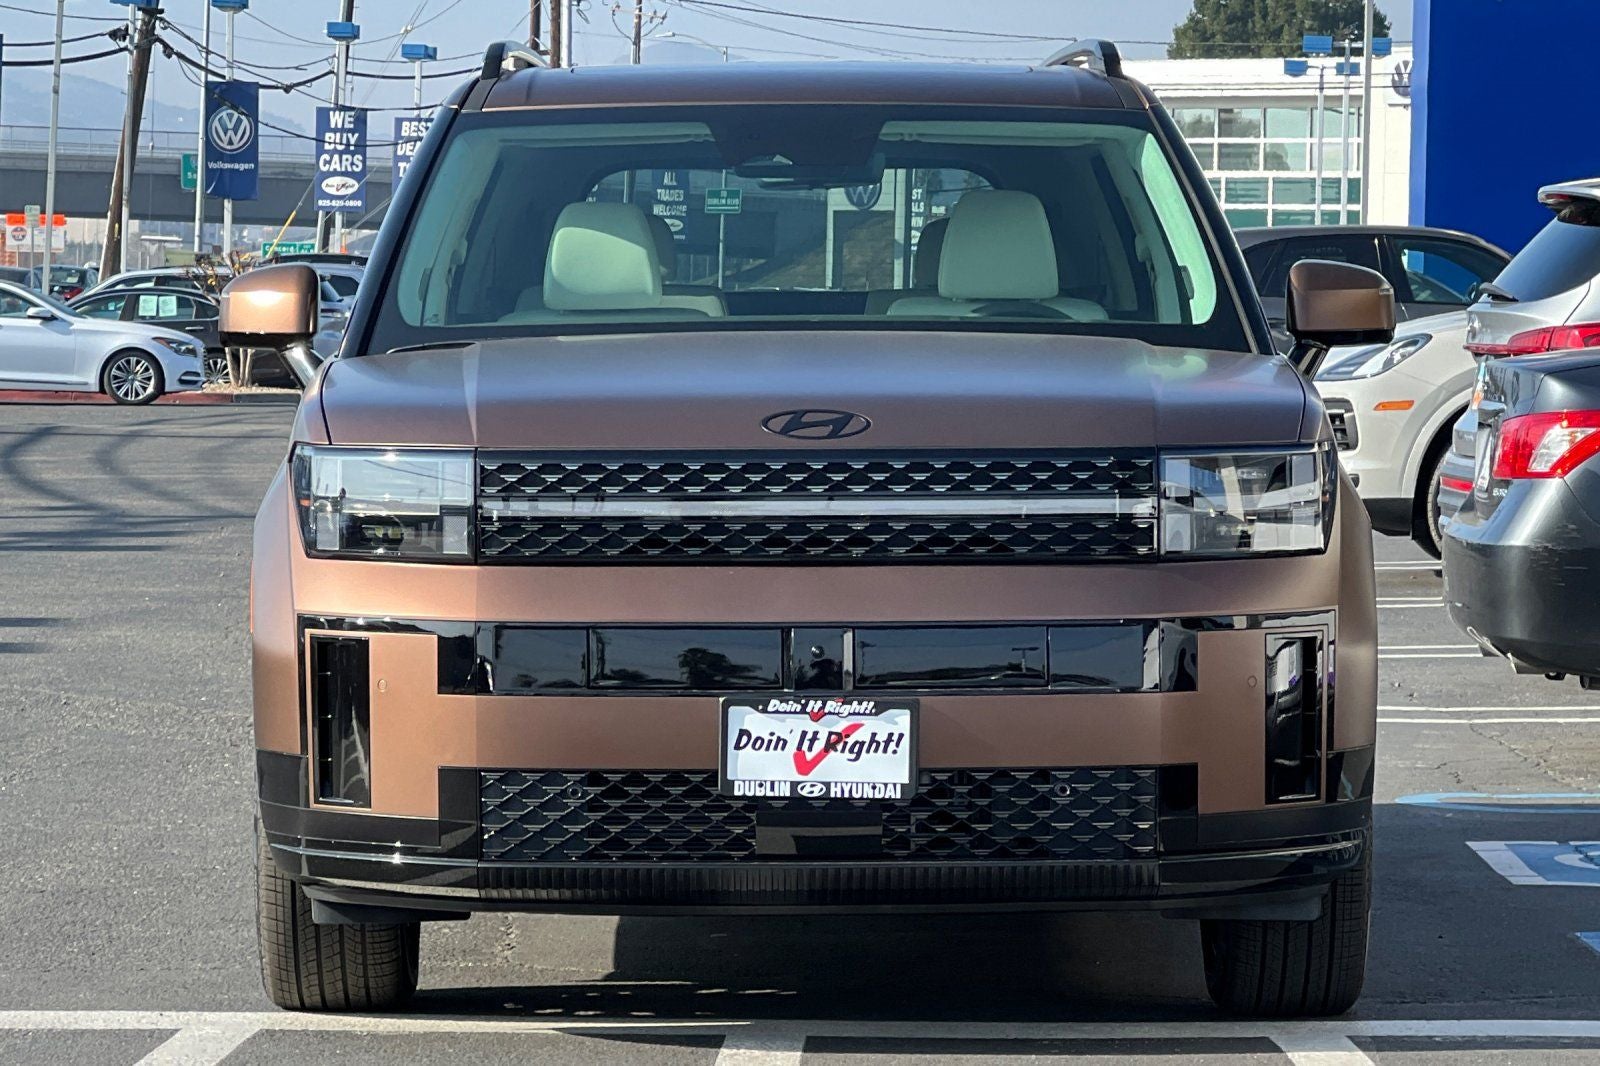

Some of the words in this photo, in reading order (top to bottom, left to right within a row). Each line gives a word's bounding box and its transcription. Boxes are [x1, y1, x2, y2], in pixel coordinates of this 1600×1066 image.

[329, 111, 354, 128] WE
[324, 132, 359, 150] BUY
[208, 161, 255, 171] Volkswagen
[319, 154, 363, 172] CARS
[663, 171, 677, 186] ALL
[656, 188, 684, 201] TRADES
[653, 204, 687, 216] WELCOME
[767, 699, 805, 713] Doin'
[806, 699, 823, 713] It
[824, 699, 875, 717] Right!
[733, 728, 793, 752] Doin'
[796, 730, 820, 752] It
[823, 731, 905, 762] Right!
[733, 780, 791, 797] DUBLIN
[830, 782, 902, 799] HYUNDAI
